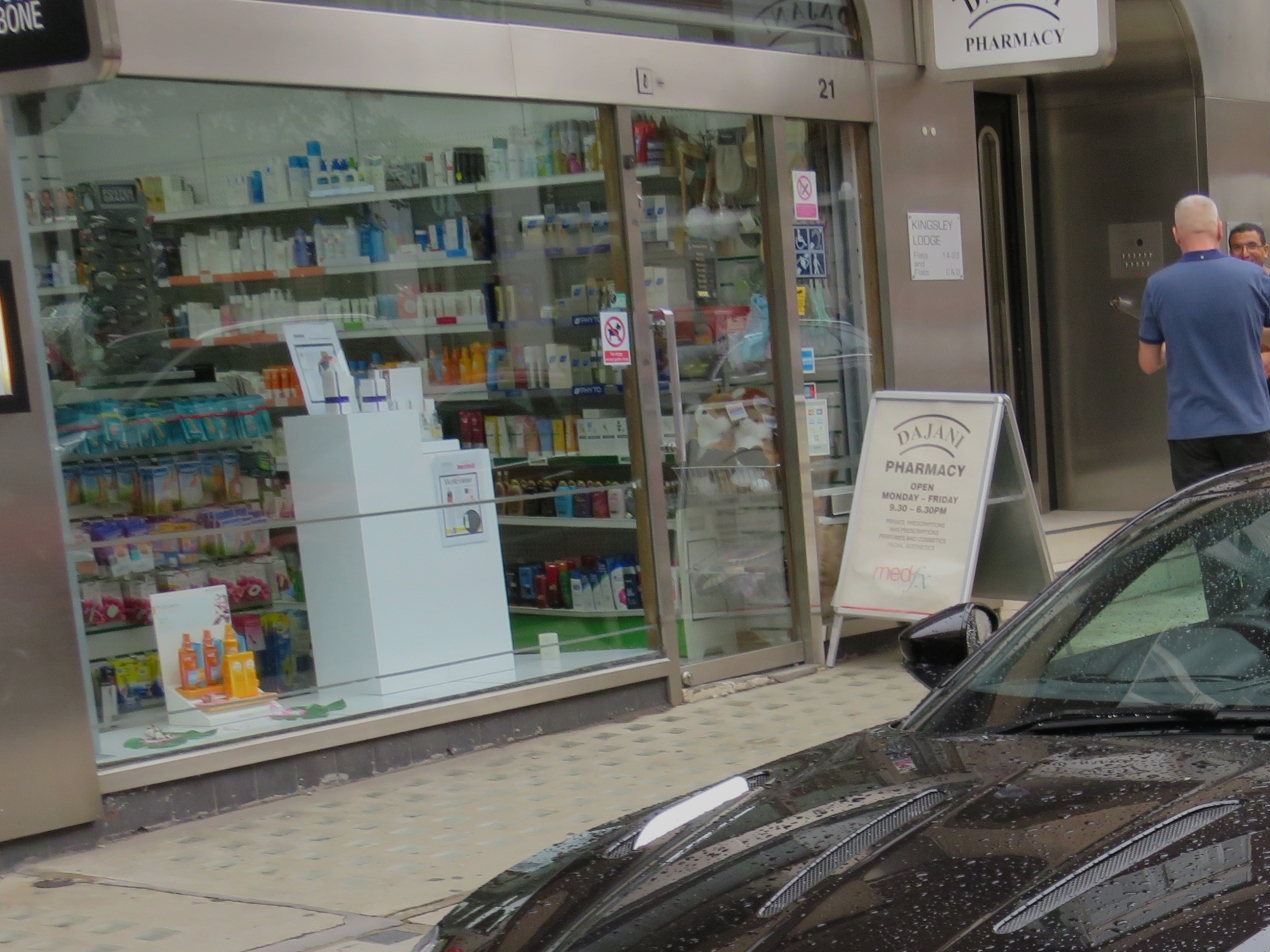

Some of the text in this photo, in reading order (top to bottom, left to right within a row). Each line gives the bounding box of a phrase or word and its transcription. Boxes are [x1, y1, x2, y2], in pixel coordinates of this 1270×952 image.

[965, 28, 1066, 52] PHARMACY
[818, 78, 835, 99] 21
[911, 219, 953, 231] KINGSLEY
[912, 234, 941, 246] LODGE
[580, 385, 602, 394] PHYTO
[897, 422, 966, 449] DAJANI
[885, 460, 967, 477] PHARMACY
[910, 482, 935, 492] OPEN
[881, 491, 919, 502] MONDAY
[927, 494, 959, 504] FRIDAY
[889, 503, 908, 513] 9.30
[916, 506, 948, 516] 6.30PM
